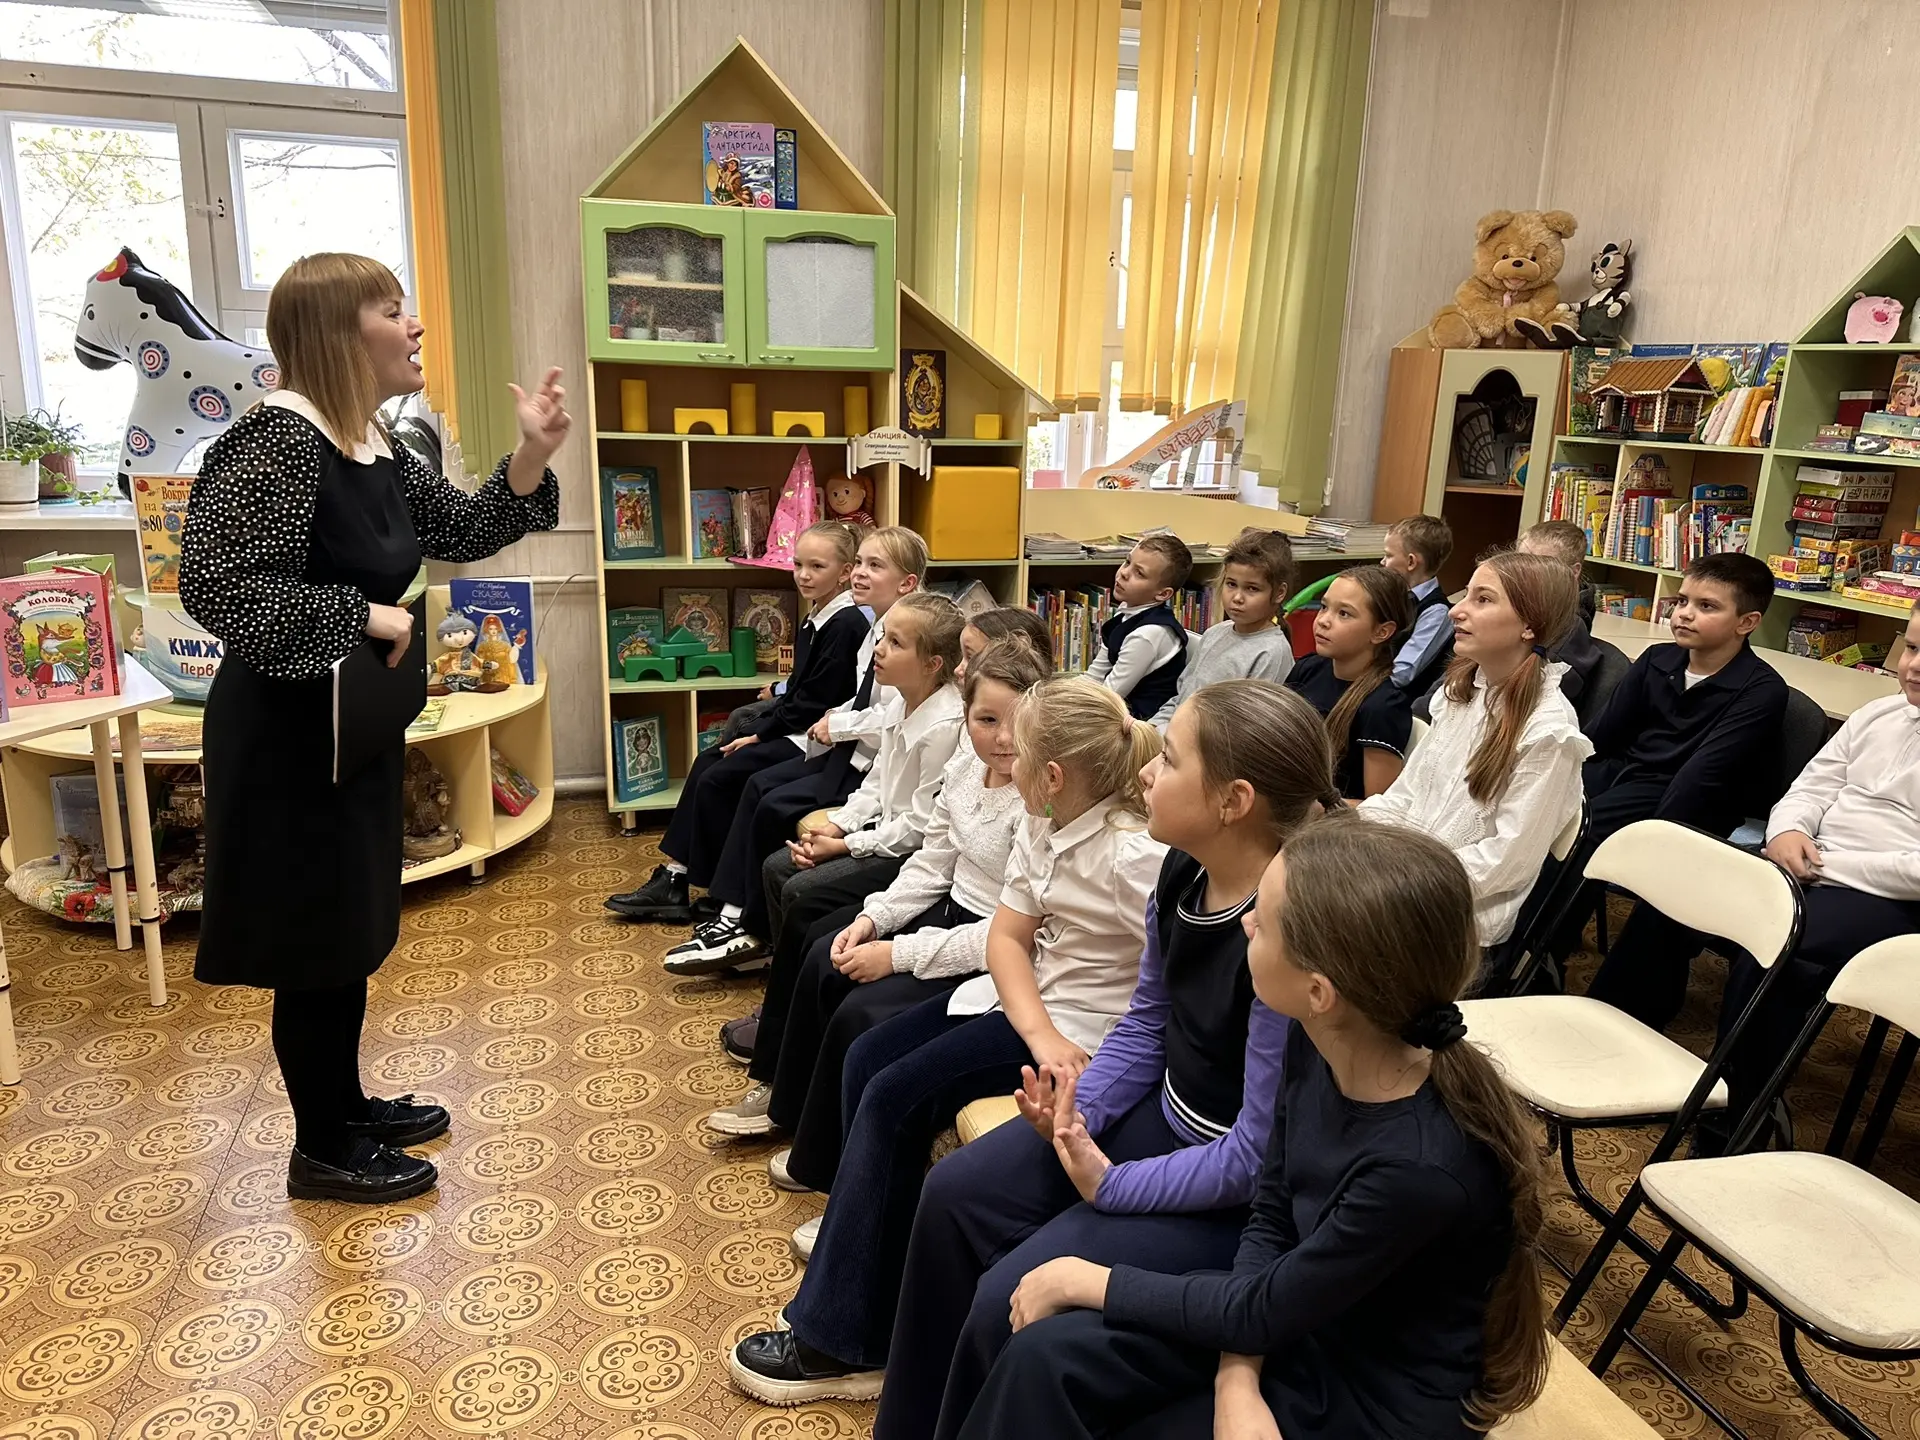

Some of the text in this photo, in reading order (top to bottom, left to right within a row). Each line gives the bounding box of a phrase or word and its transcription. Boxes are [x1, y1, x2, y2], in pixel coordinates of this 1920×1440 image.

[723, 130, 761, 140] АРКТИКА
[716, 142, 770, 151] АНТАРКТИДА
[869, 432, 901, 440] СТАНЦИЯ
[144, 503, 157, 511] на
[149, 514, 163, 532] 80
[472, 589, 511, 599] СКАЗКА
[27, 596, 75, 607] КОЛОБОК
[180, 662, 216, 678] Перв
